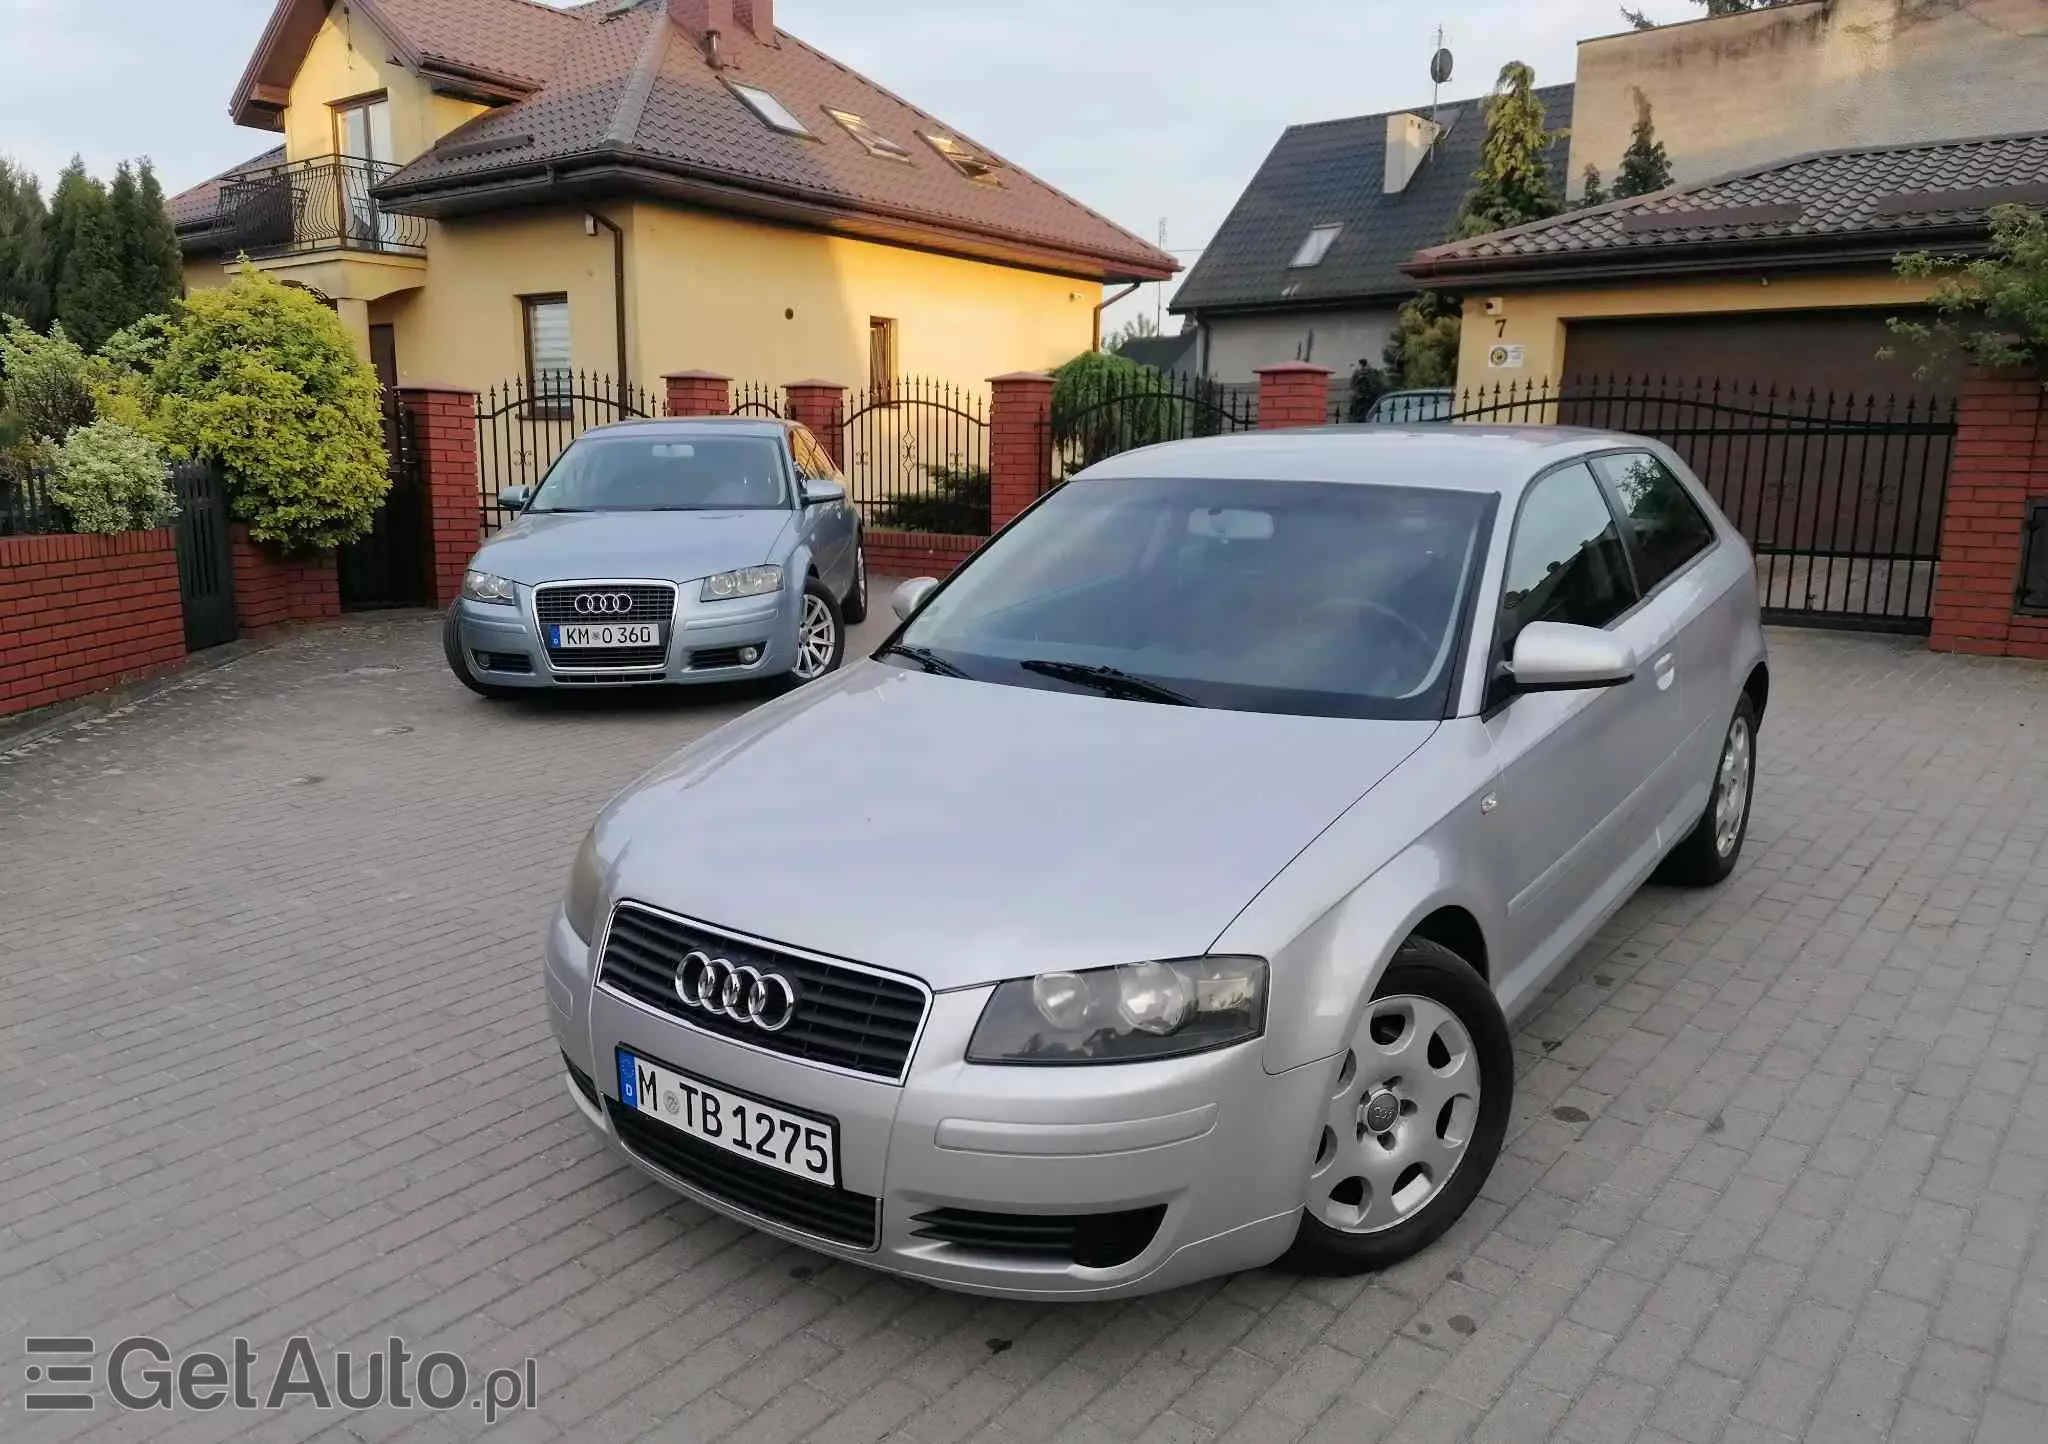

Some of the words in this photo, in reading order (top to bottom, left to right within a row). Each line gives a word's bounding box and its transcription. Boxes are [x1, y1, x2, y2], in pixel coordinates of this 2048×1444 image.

[1495, 318, 1507, 338] 7
[566, 627, 590, 645] KM
[637, 1063, 658, 1112] M
[679, 1081, 723, 1138] TB
[732, 1105, 828, 1174] 1275
